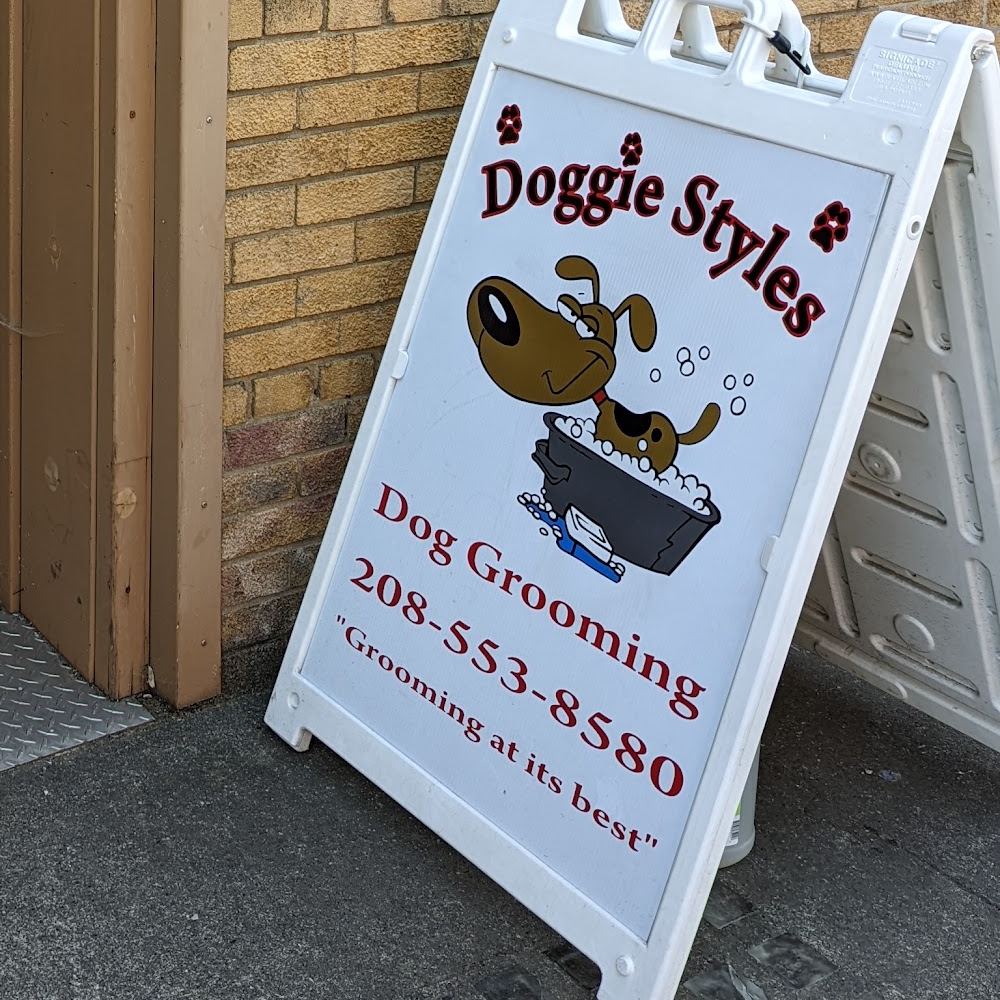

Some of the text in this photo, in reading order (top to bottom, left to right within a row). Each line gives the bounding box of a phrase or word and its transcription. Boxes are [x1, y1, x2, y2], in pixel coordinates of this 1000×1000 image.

[481, 158, 826, 337] Doggie Styles
[350, 557, 685, 798] 208-553-8580
[373, 481, 707, 721] Dog Grooming
[336, 615, 659, 852] "Grooming at its best"
